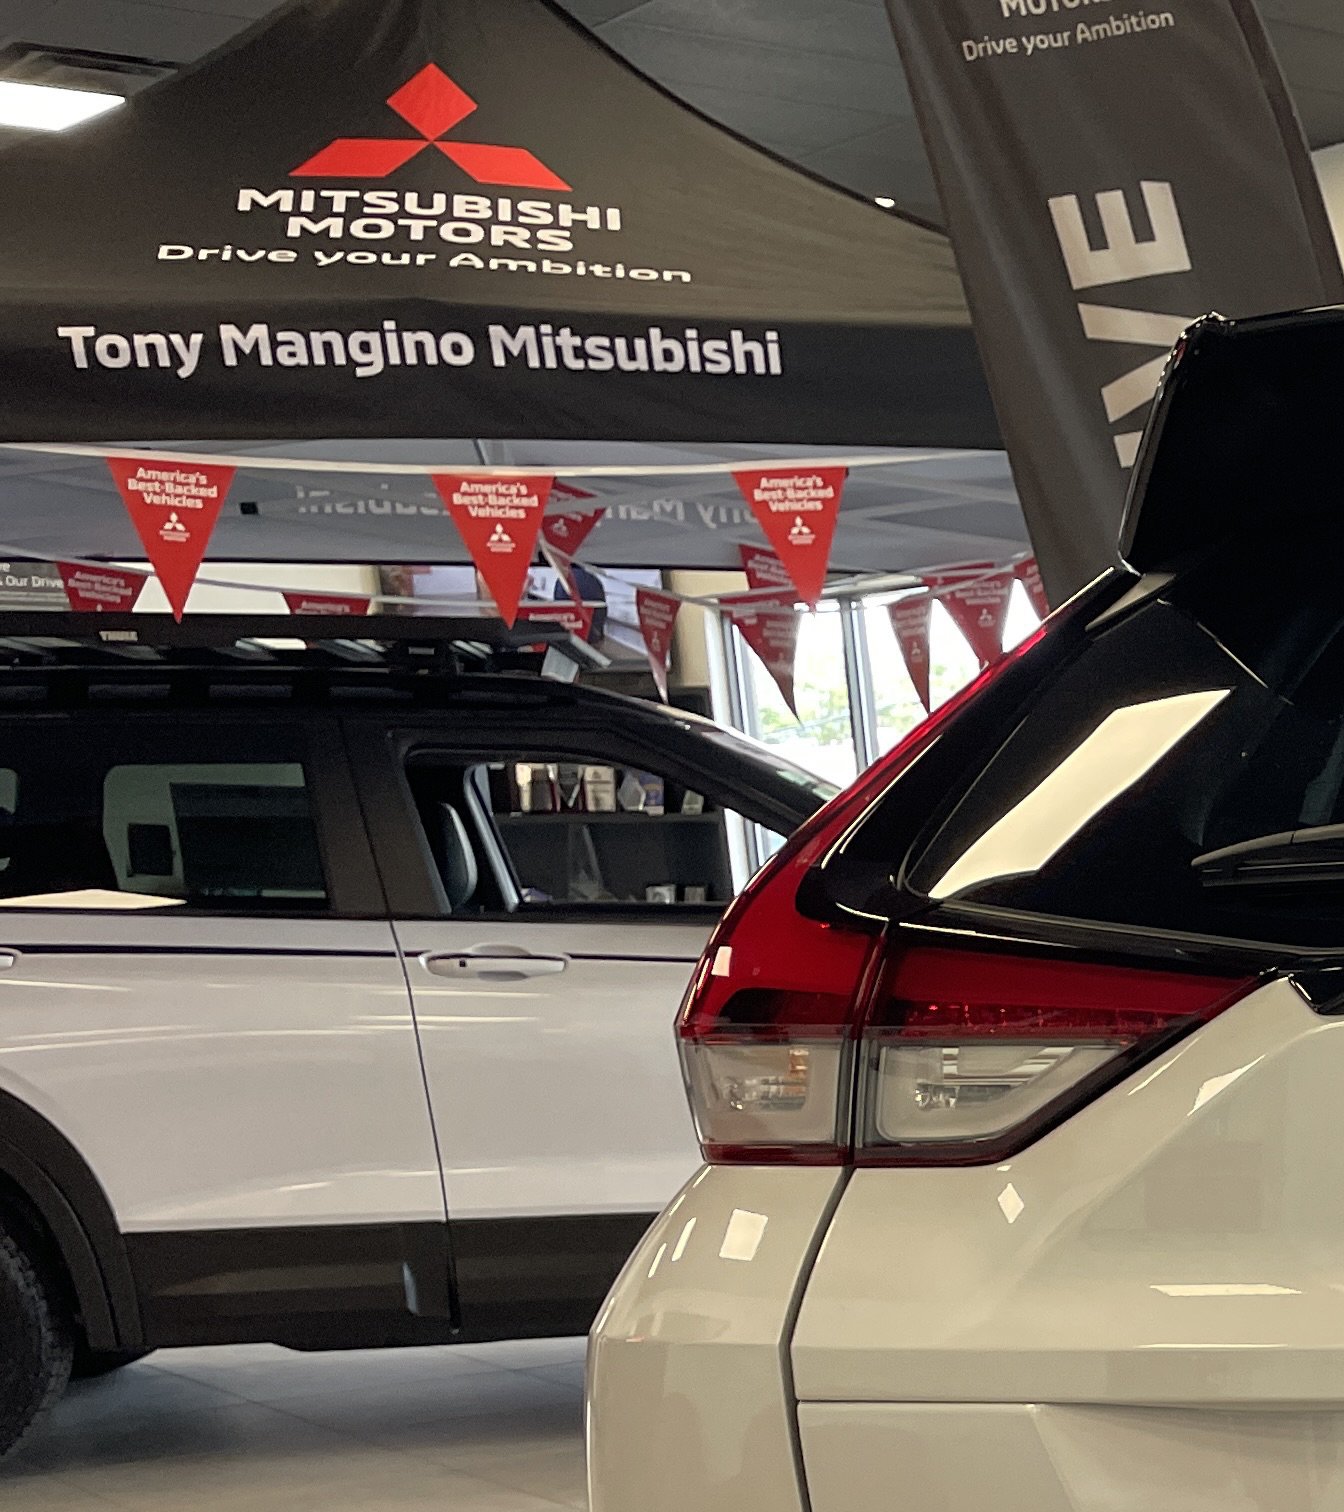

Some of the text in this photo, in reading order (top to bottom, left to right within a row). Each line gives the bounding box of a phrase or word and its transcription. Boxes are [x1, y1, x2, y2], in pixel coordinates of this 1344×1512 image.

[962, 11, 1175, 61] Drive your Ambition
[237, 188, 621, 231] MITSUBISHI
[287, 216, 574, 252] MOTORS
[157, 245, 692, 283] Drive your Ambition
[57, 320, 782, 379] Tony Mangino Mitsubishi
[136, 467, 207, 484] America's
[760, 474, 823, 489] America's
[127, 478, 218, 498] Best-Backed
[460, 481, 528, 495] America's
[753, 486, 834, 502] Best-Backed
[143, 492, 203, 509] Vehicles
[452, 492, 539, 508] Best-Backed
[768, 499, 823, 513] Vehicles
[468, 505, 526, 519] Vehicles
